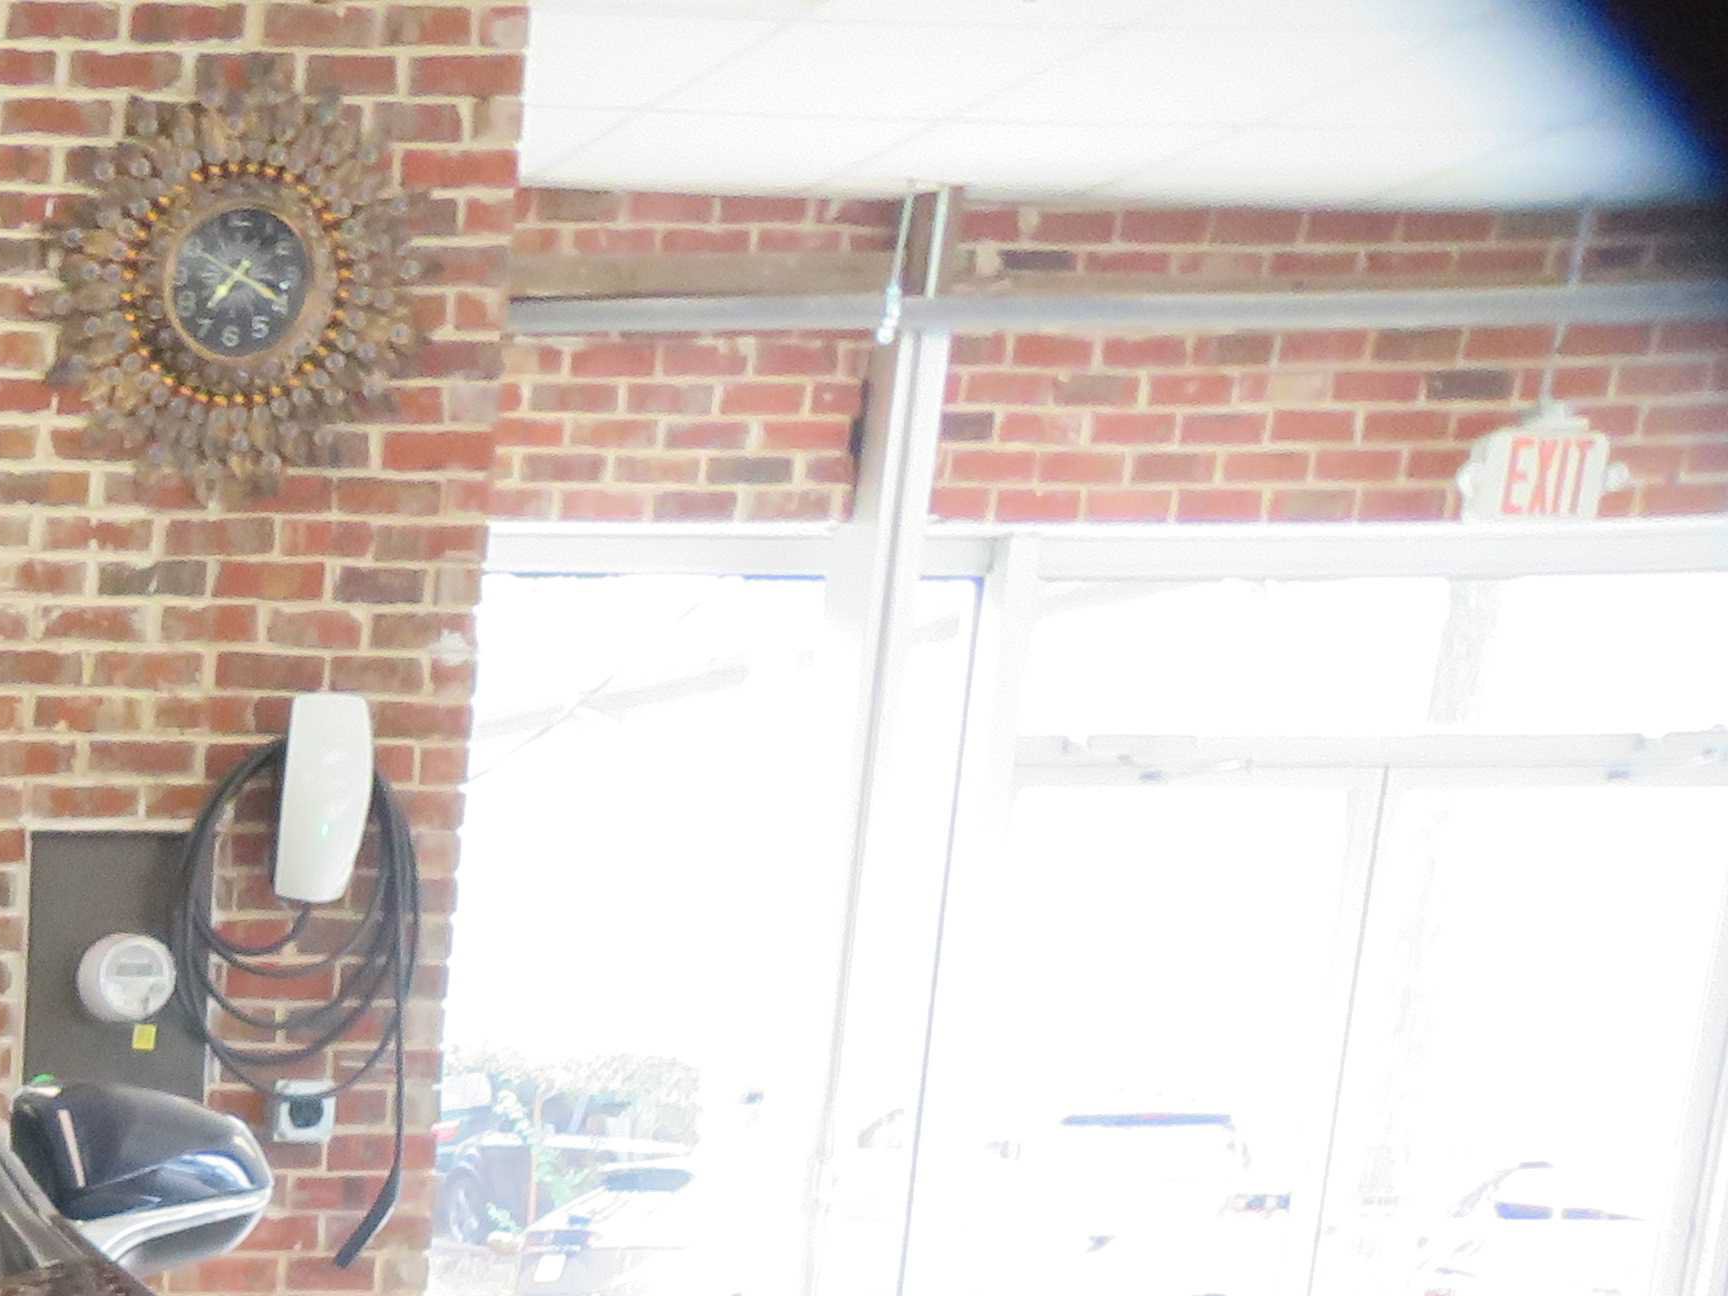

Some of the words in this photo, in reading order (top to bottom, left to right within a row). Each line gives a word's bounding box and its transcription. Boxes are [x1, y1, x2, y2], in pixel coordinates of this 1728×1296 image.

[196, 318, 215, 337] 7
[221, 325, 240, 347] 6
[251, 315, 270, 338] 5
[1501, 436, 1596, 514] EXIT
